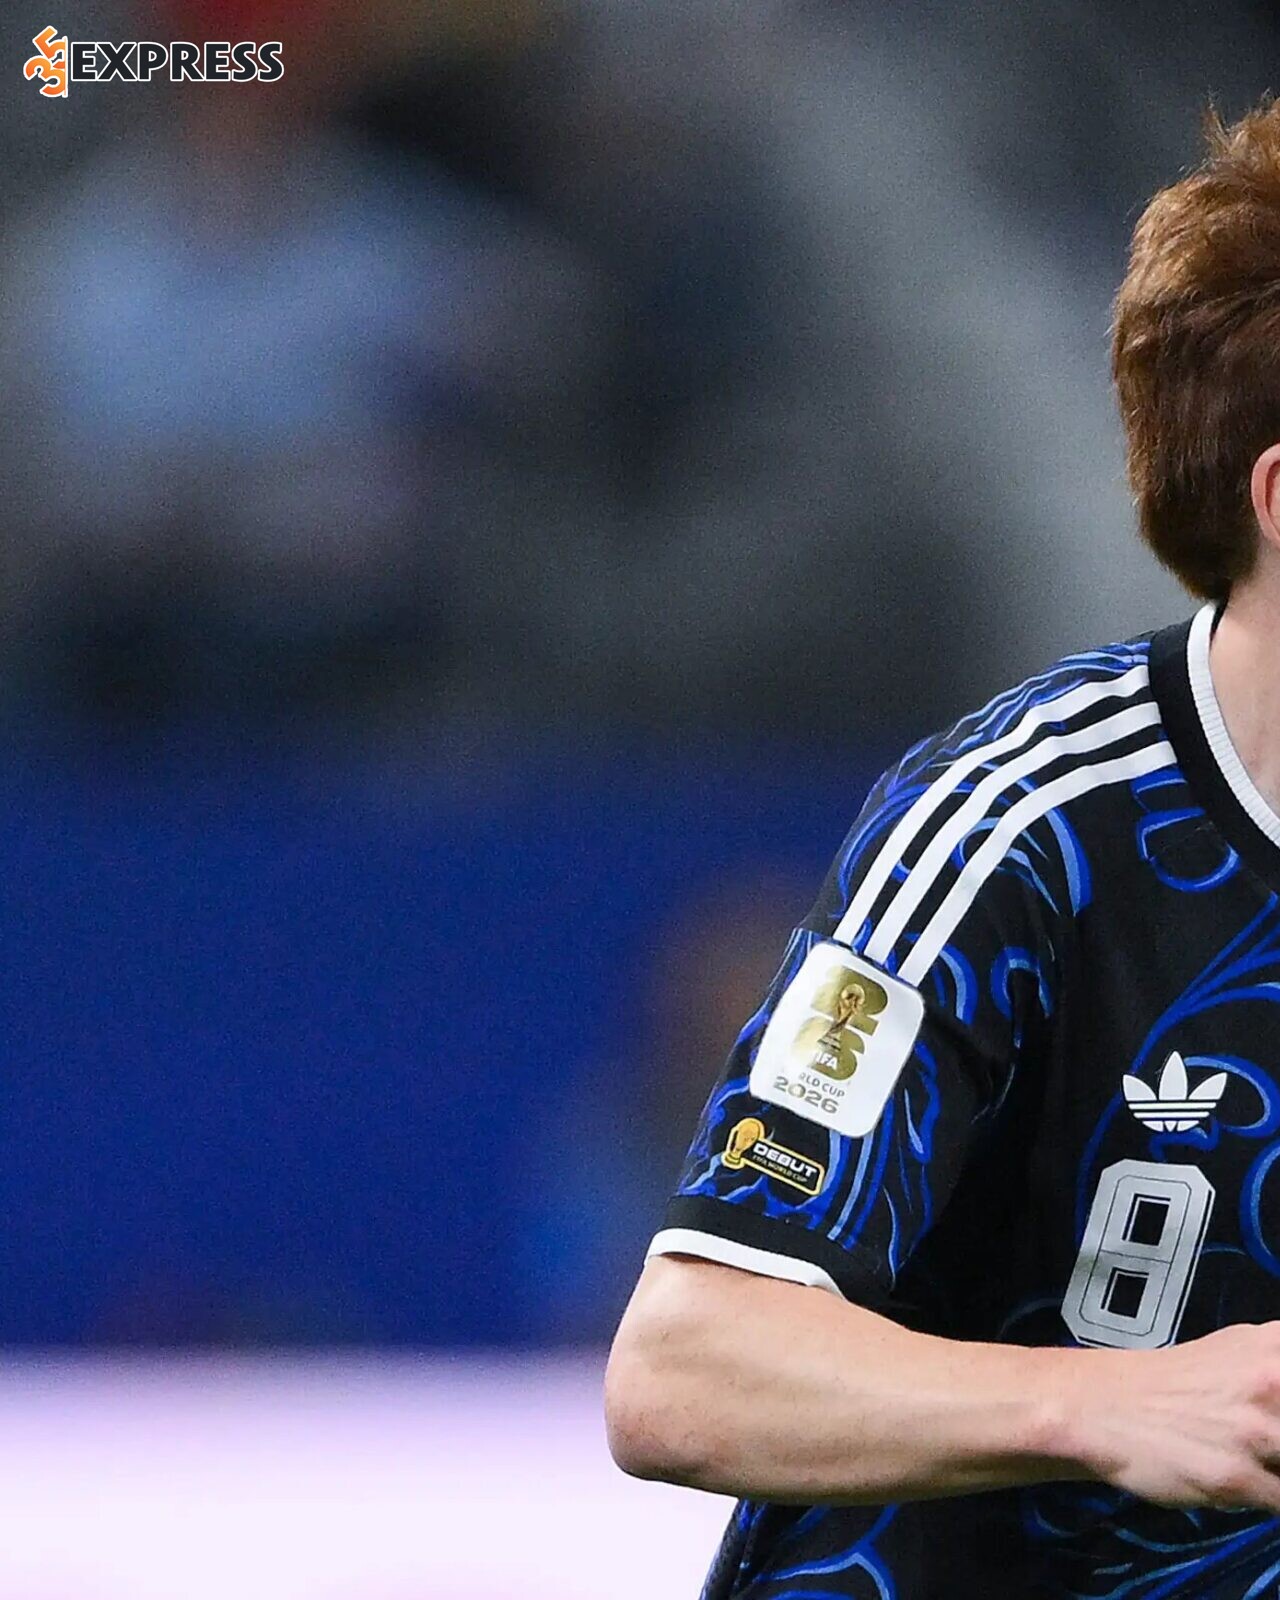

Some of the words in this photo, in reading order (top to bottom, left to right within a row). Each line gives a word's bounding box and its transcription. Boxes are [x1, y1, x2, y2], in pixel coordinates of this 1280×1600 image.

[773, 1075, 840, 1115] 2026
[821, 1083, 846, 1098] CUP
[753, 1142, 818, 1178] DEBUT
[1061, 1158, 1216, 1349] 8
